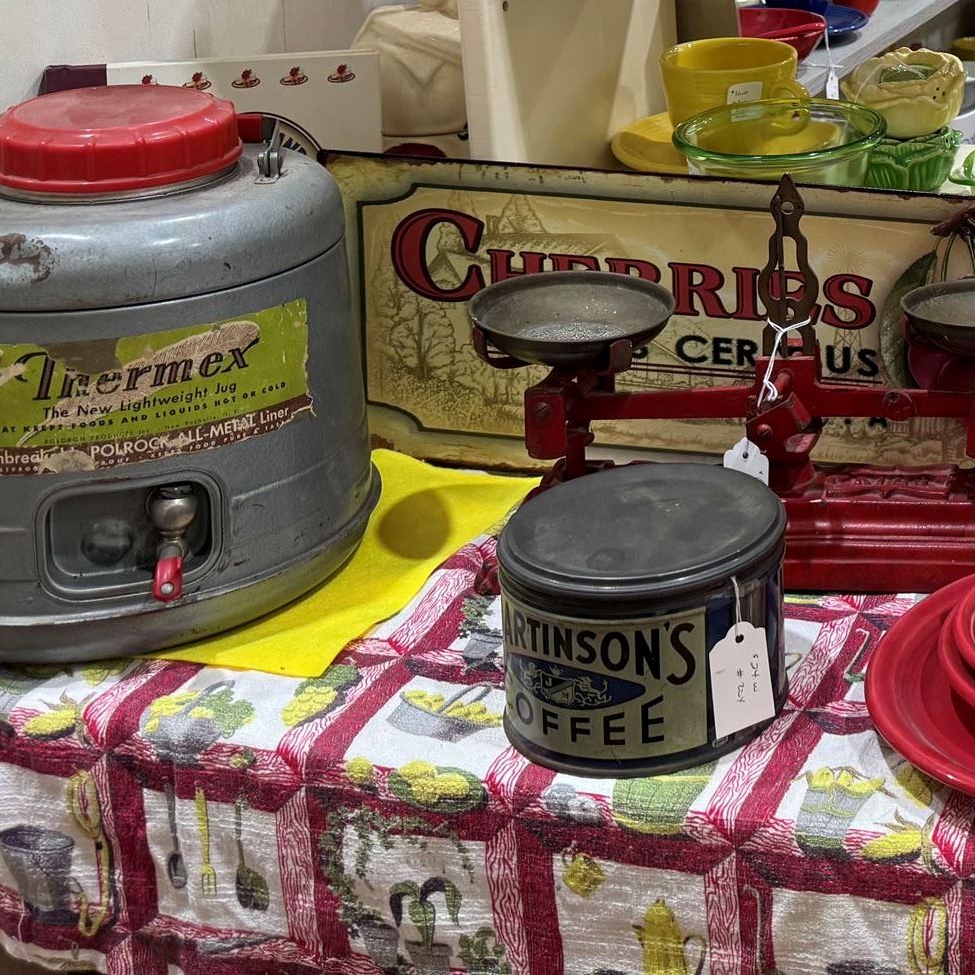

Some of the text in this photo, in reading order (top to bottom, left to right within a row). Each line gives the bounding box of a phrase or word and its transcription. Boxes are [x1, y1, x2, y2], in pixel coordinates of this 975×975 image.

[676, 335, 879, 375] CERUS
[44, 381, 237, 419] The New Lightweight Jug
[71, 419, 114, 429] FOODS
[121, 415, 148, 424] AND
[156, 403, 208, 418] LIQUIDS
[214, 396, 237, 407] HOT
[243, 391, 256, 399] OR
[261, 381, 286, 393] COLD
[91, 433, 168, 458] POLROCK
[178, 412, 257, 442] ALL-METAL
[260, 407, 290, 424] Liner
